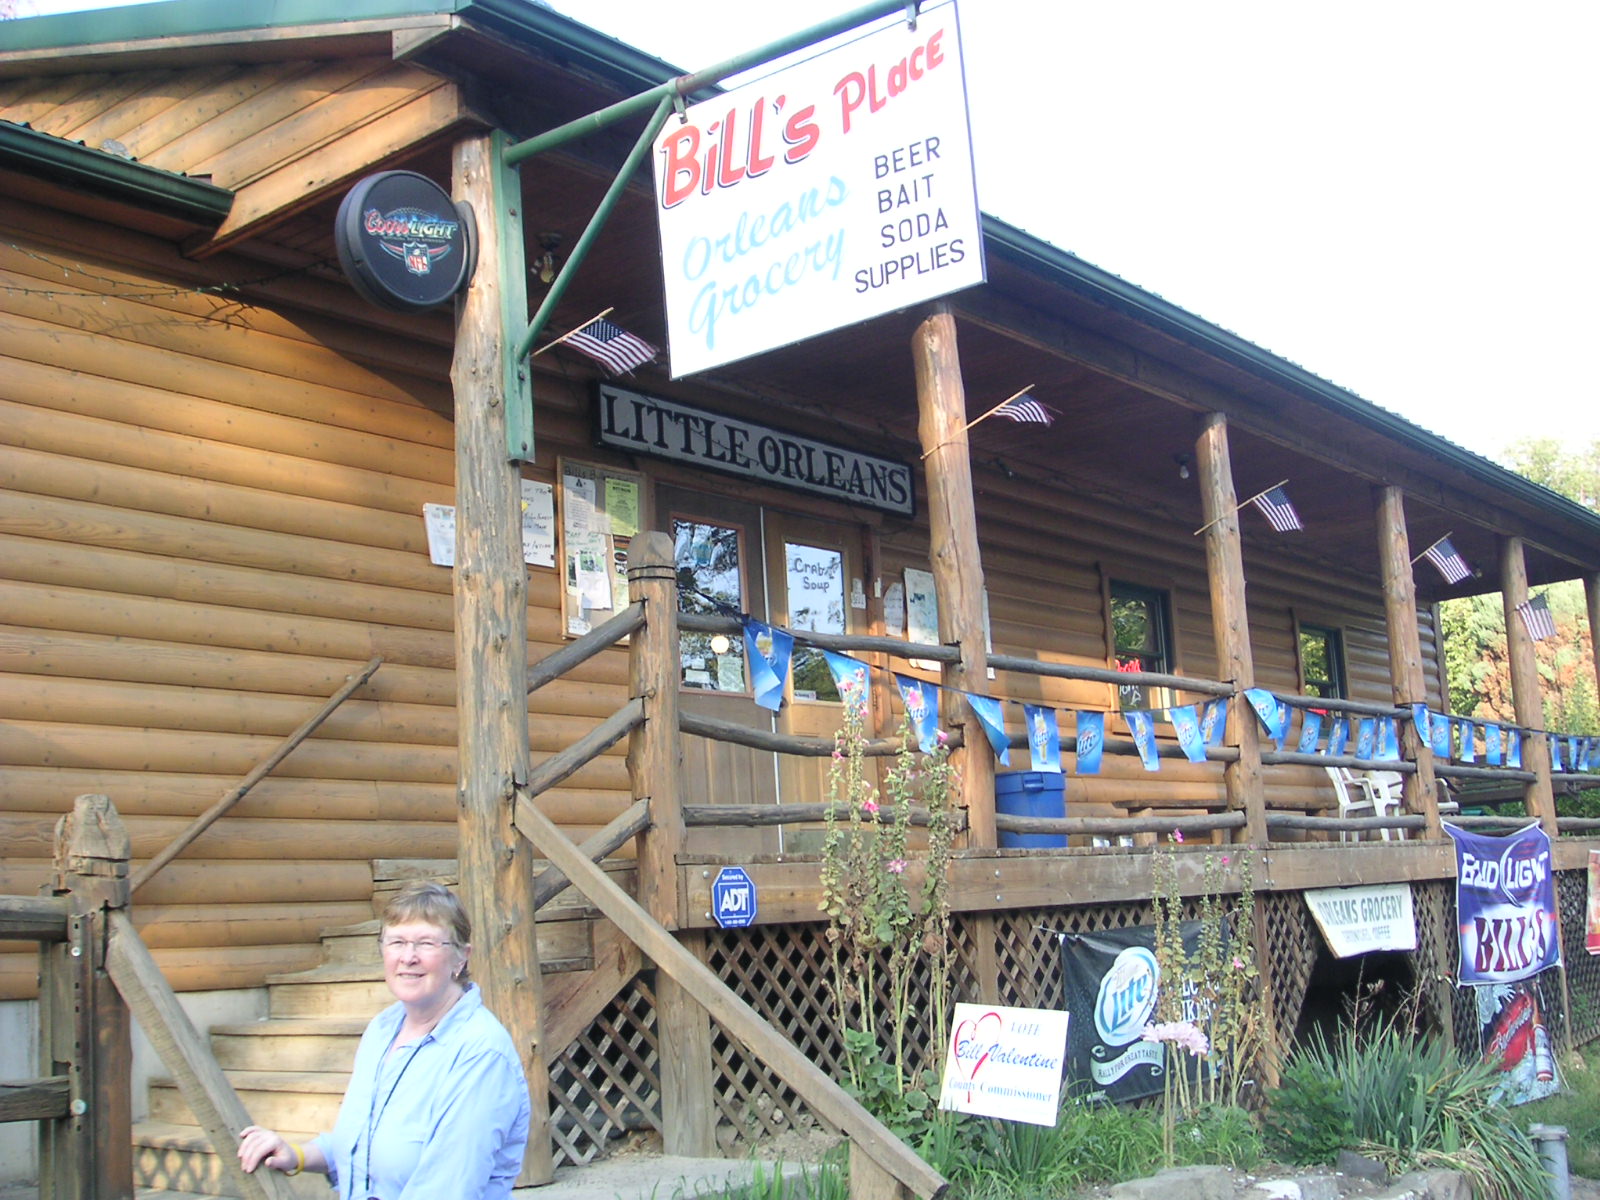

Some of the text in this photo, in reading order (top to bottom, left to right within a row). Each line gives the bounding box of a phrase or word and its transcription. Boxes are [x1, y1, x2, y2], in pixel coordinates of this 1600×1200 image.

[874, 136, 941, 180] BEER
[877, 173, 935, 214] BAIT
[409, 219, 457, 239] LIGHT
[682, 175, 850, 281] Orleans
[881, 207, 949, 249] SODA
[854, 239, 965, 294] SUPPLIES
[688, 228, 845, 350] Grocery
[602, 393, 908, 505] LITTLE ORLEANS
[1461, 852, 1500, 889] BUD
[720, 887, 749, 912] ADT
[1361, 894, 1403, 922] GROCERY
[1108, 973, 1149, 1033] Lite
[956, 1039, 1058, 1070] Bill Valentine
[979, 1081, 1053, 1103] Commissioner
